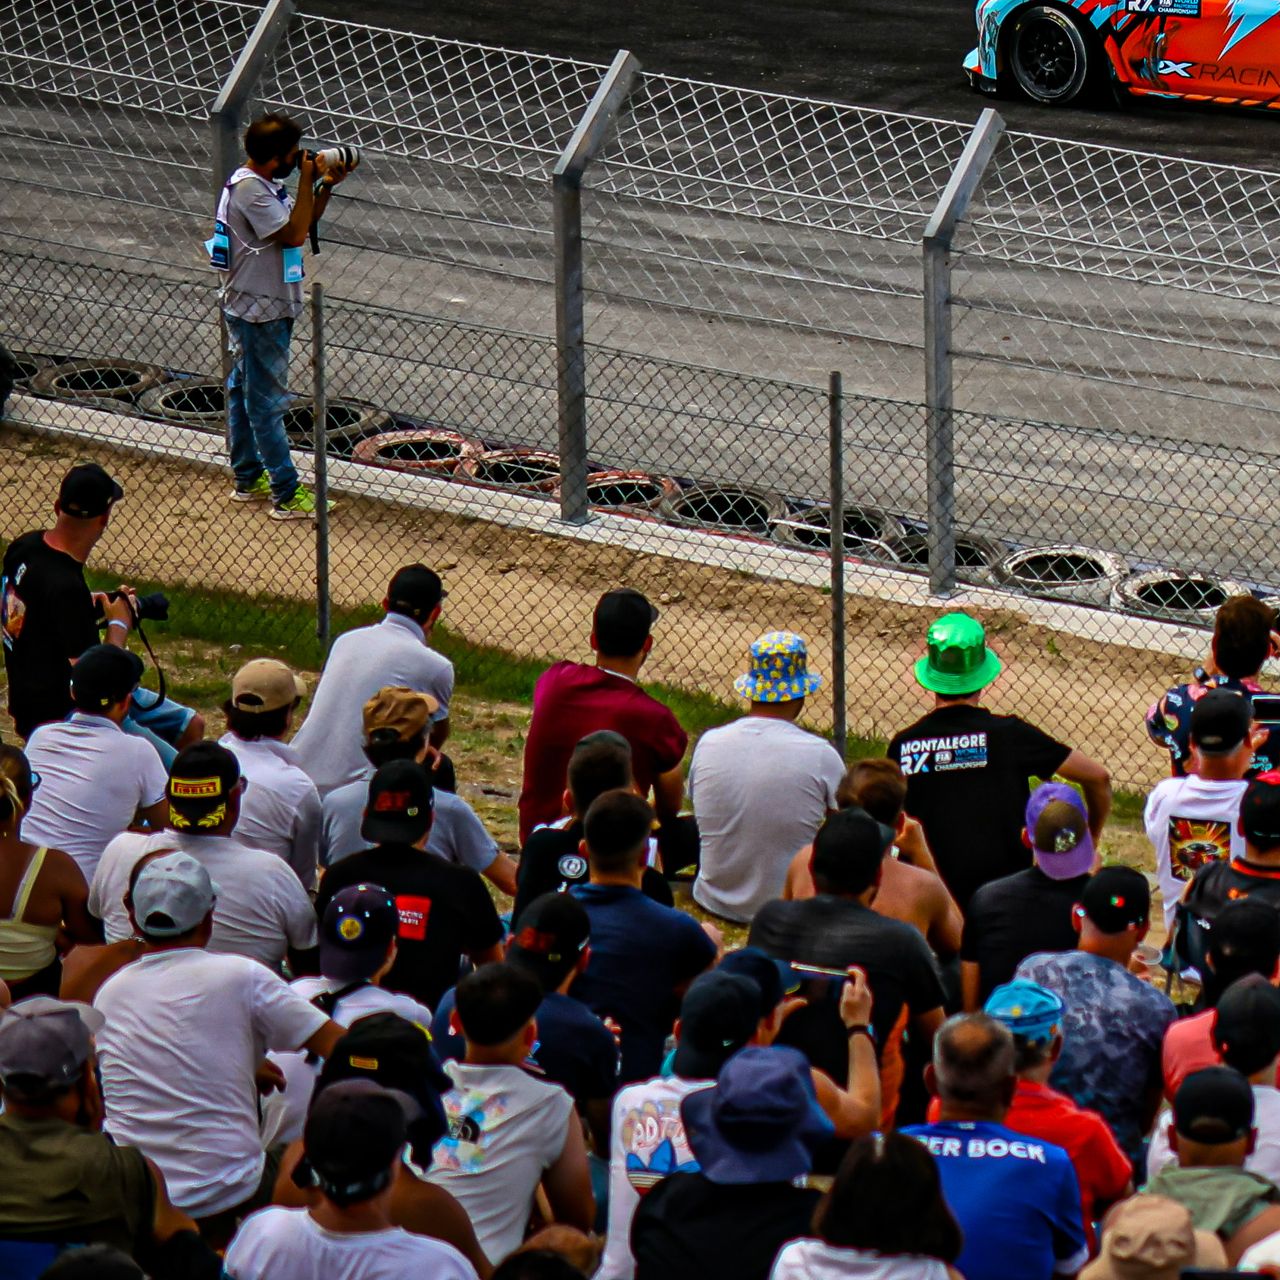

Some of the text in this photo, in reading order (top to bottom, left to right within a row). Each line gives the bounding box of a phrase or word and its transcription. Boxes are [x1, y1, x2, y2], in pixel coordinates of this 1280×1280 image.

[1157, 6, 1198, 15] CHAMPIONSHIP
[900, 732, 987, 757] MONTALEGRE
[900, 752, 930, 776] RX
[967, 1138, 1047, 1164] BOCK
